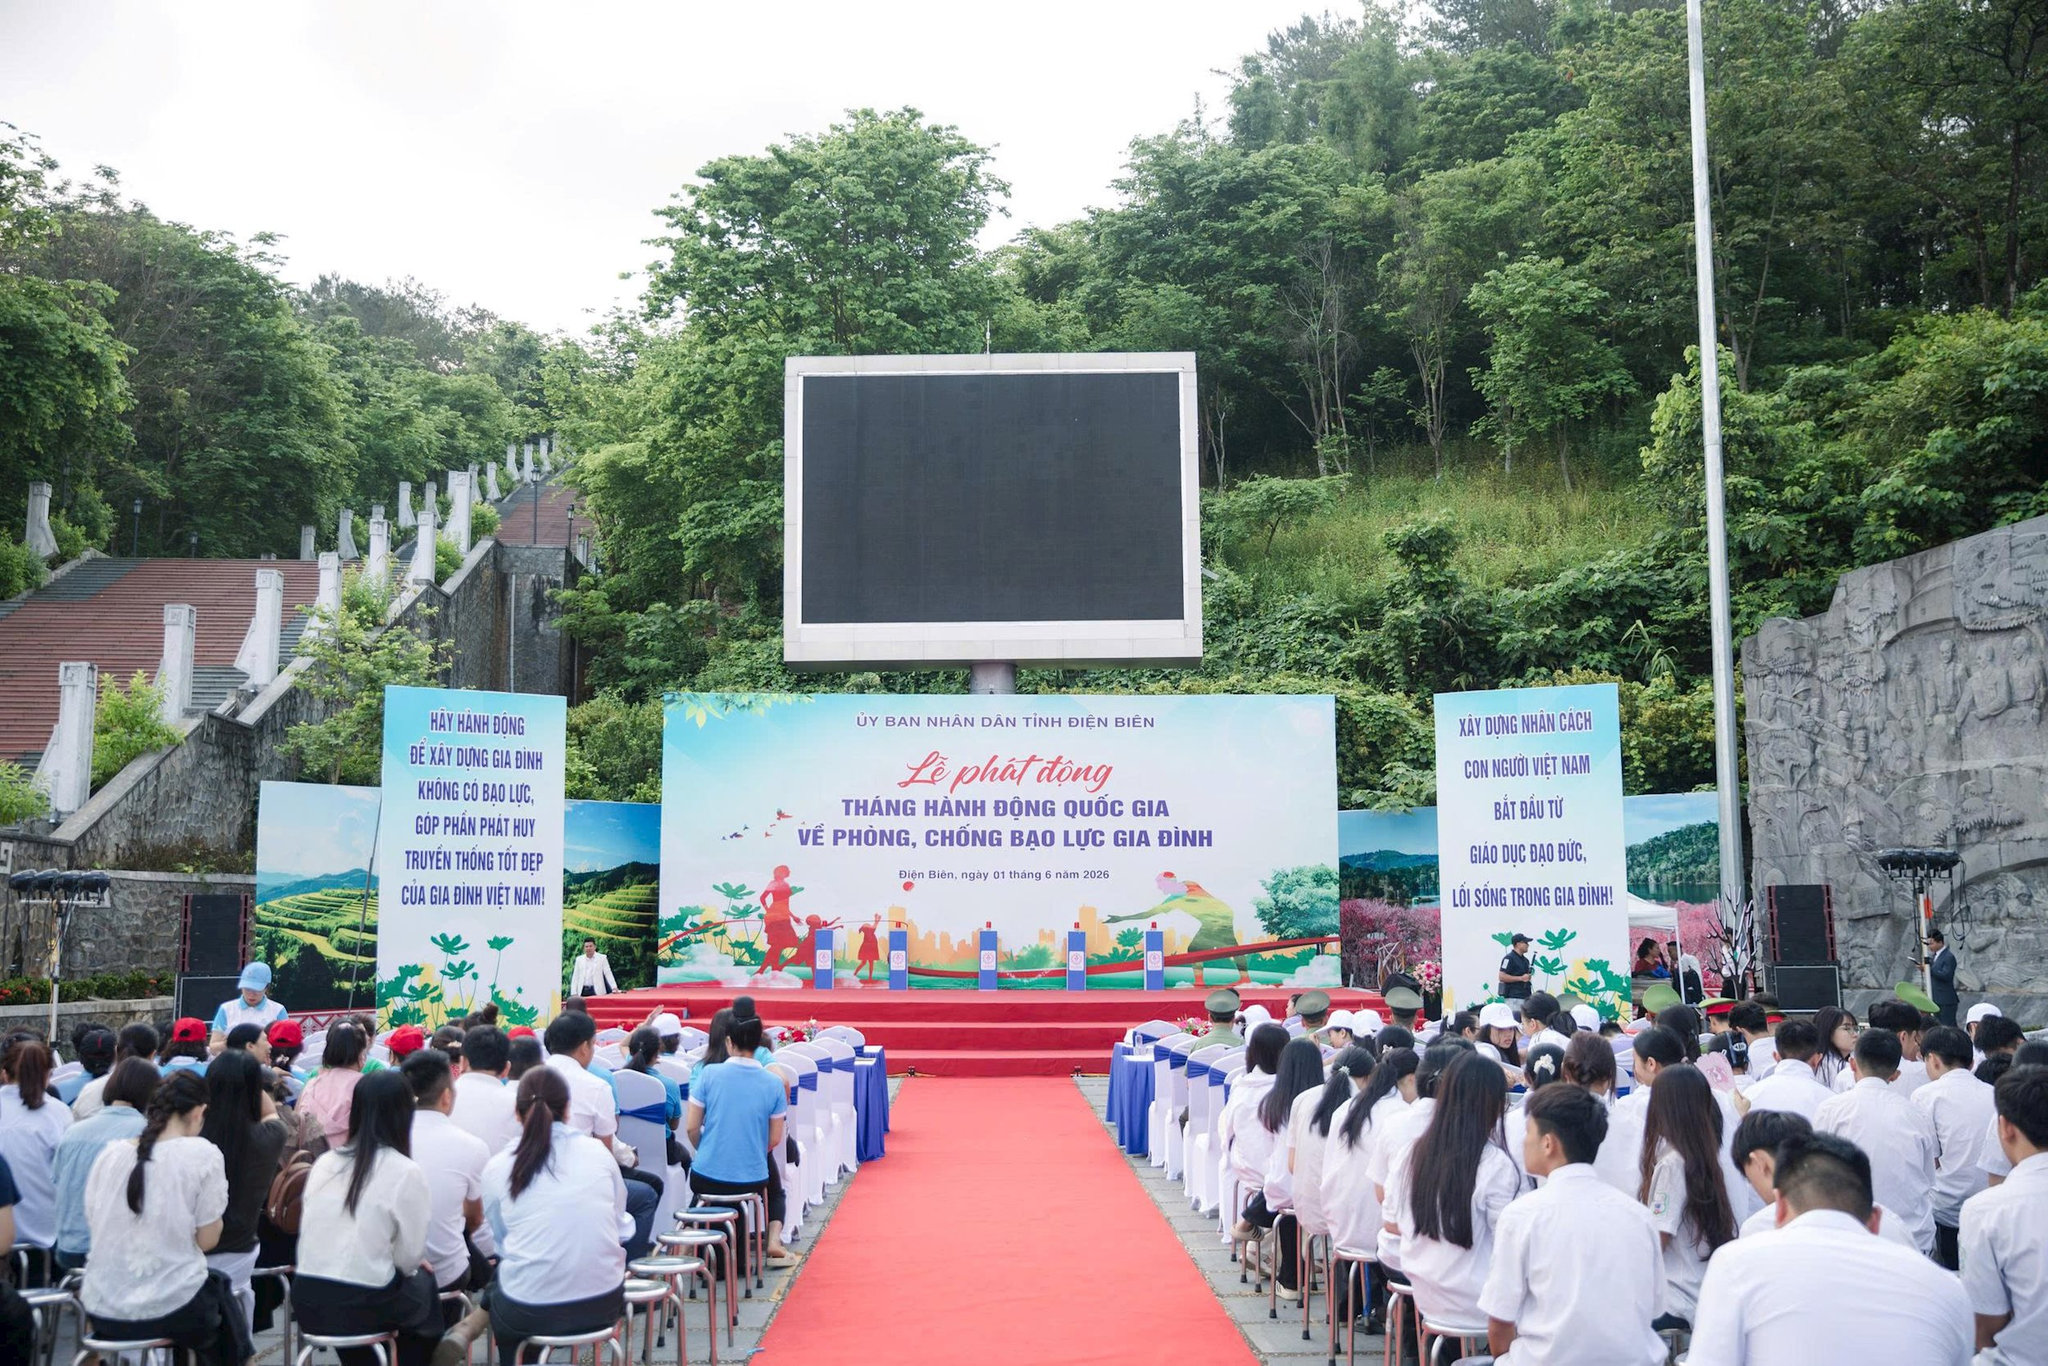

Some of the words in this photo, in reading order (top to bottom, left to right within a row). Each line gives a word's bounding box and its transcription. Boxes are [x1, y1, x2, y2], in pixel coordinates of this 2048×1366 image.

[430, 708, 454, 732] HÃY
[457, 710, 490, 734] HÀNH
[493, 712, 525, 739] ĐỘNG
[856, 712, 879, 727] ỦY
[885, 716, 921, 727] BAN
[926, 714, 975, 728] NHÂN
[981, 714, 1017, 728] DÂN
[1022, 713, 1062, 728] TỈNH
[1068, 714, 1108, 730] ĐIỆN
[1115, 714, 1155, 728] BIÊN
[1459, 714, 1481, 737] XÂY
[1485, 714, 1518, 739] DỰNG
[1521, 710, 1556, 733] NHÂN
[1559, 708, 1592, 732] CÁCH
[410, 738, 426, 765] ĐỂ
[429, 742, 453, 766] XÂY
[457, 746, 489, 771] DỰNG
[492, 749, 511, 769] GIA
[515, 747, 543, 770] ĐÌNH
[1464, 759, 1489, 779] CON
[1492, 753, 1529, 778] NGƯỜI
[1532, 752, 1557, 780] VIỆT
[1561, 755, 1591, 775] NAM
[897, 751, 951, 788] Lễ
[950, 754, 1044, 794] phát
[1036, 755, 1113, 793] động
[418, 777, 459, 801] KHÔNG
[463, 778, 479, 801] CÓ
[483, 783, 506, 807] BẠO
[509, 782, 534, 808] LỰC,
[1494, 794, 1516, 820] BẮT
[1520, 793, 1544, 820] ĐẦU
[1548, 795, 1564, 819] TỪ
[841, 795, 917, 817] THÁNG
[924, 796, 986, 817] HÀNH
[993, 796, 1056, 821] ĐỘNG
[1064, 794, 1124, 819] QUỐC
[1132, 800, 1170, 817] GIA
[415, 811, 440, 835] GÓP
[443, 810, 476, 836] PHẦN
[480, 813, 510, 837] PHÁT
[513, 818, 536, 837] HUY
[798, 824, 825, 847] VỀ
[832, 825, 917, 848] PHÒNG,
[925, 824, 1003, 847] CHỐNG
[1010, 830, 1055, 851] BẠO
[1063, 828, 1106, 851] LỰC
[1113, 830, 1151, 847] GIA
[1158, 826, 1213, 847] ĐÌNH
[405, 844, 452, 870] TRUYỀN
[455, 844, 494, 871] THỐNG
[498, 845, 518, 871] TỐT
[521, 852, 544, 876] ĐẸP
[1470, 841, 1498, 864] GIÁO
[1502, 844, 1526, 868] DỤC
[1530, 843, 1554, 867] ĐẠO
[1558, 838, 1587, 864] ĐỨC,
[899, 870, 925, 880] Điện
[928, 870, 958, 881] Biên,
[961, 871, 989, 881] ngày
[993, 871, 1005, 880] 01
[1009, 870, 1042, 881] tháng
[1045, 871, 1052, 880] 6
[1055, 870, 1080, 880] năm
[1083, 870, 1110, 880] 2026
[401, 879, 426, 905] CỦA
[430, 885, 450, 905] GIA
[454, 882, 483, 905] ĐÌNH
[486, 882, 511, 910] VIỆT
[514, 886, 545, 906] NAM!
[1453, 881, 1471, 908] LỐI
[1474, 881, 1507, 907] SỐNG
[1510, 887, 1551, 907] TRONG
[1554, 886, 1575, 906] GIA
[1578, 882, 1614, 906] ĐÌNH!
